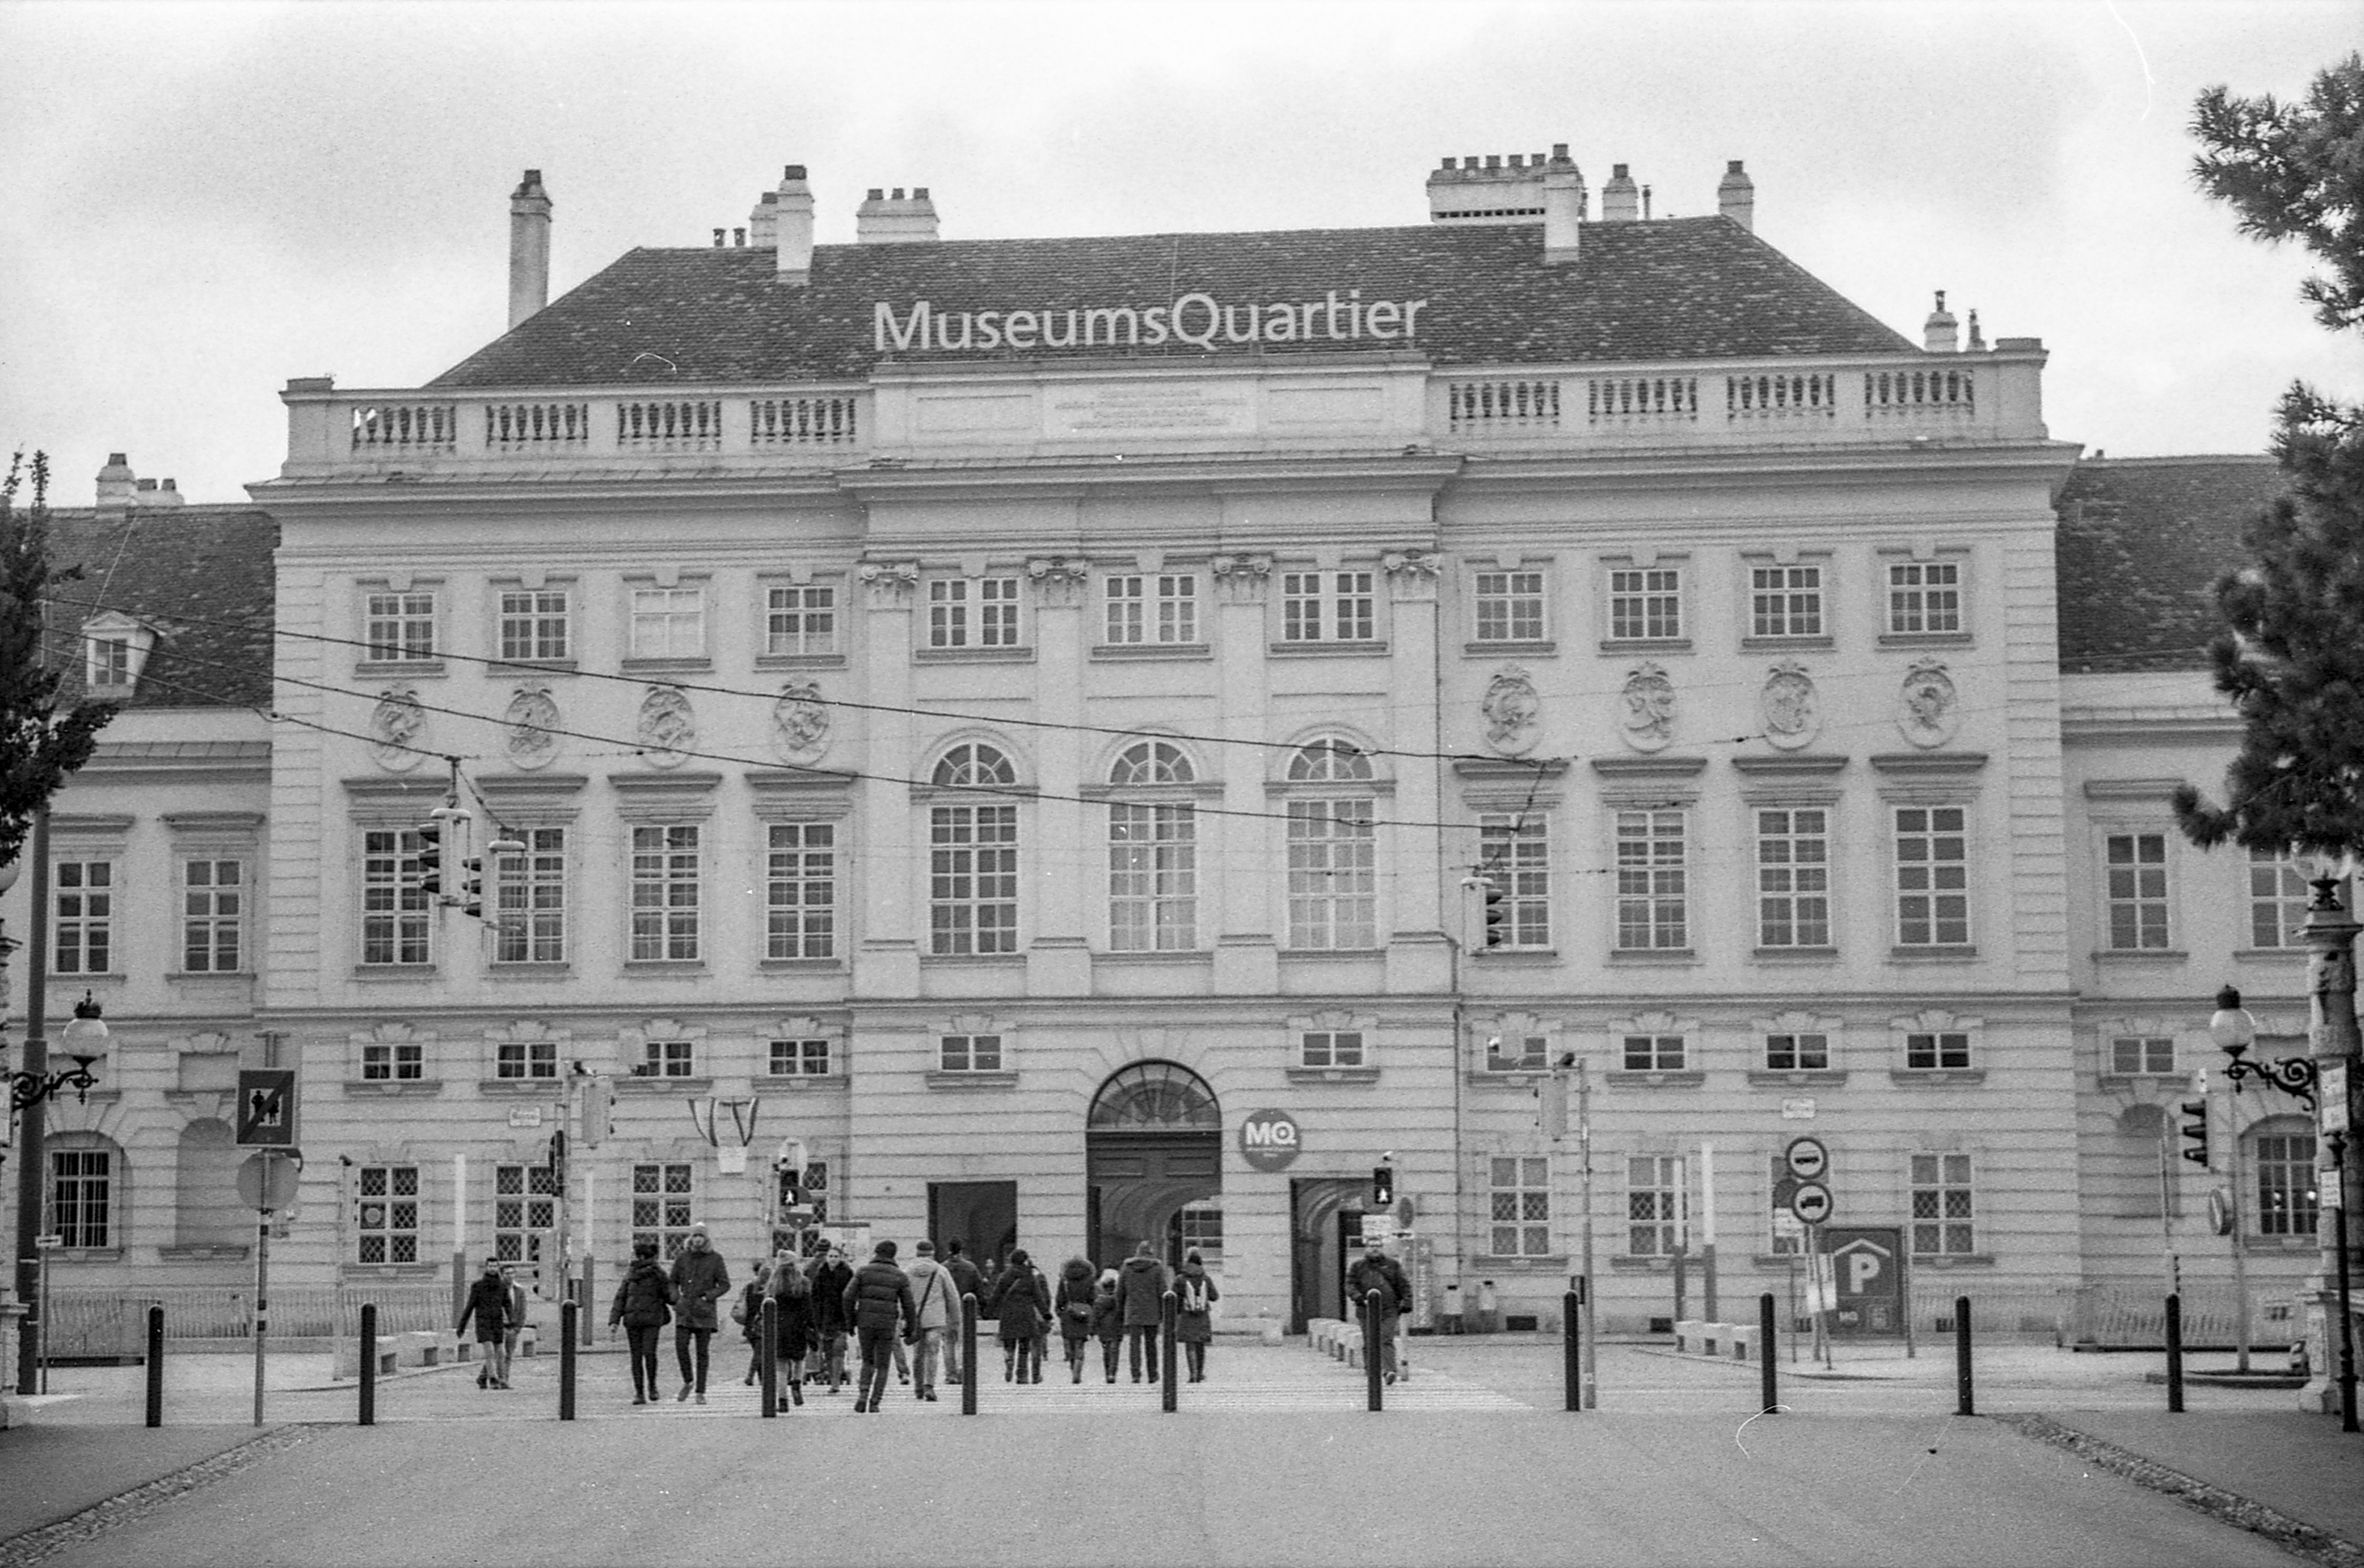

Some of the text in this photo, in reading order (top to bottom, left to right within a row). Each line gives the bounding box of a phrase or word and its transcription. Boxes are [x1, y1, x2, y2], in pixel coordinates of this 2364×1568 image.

[873, 290, 1427, 351] MuseumsQuartier
[1246, 1121, 1296, 1145] MQ
[1850, 1253, 1879, 1293] P
